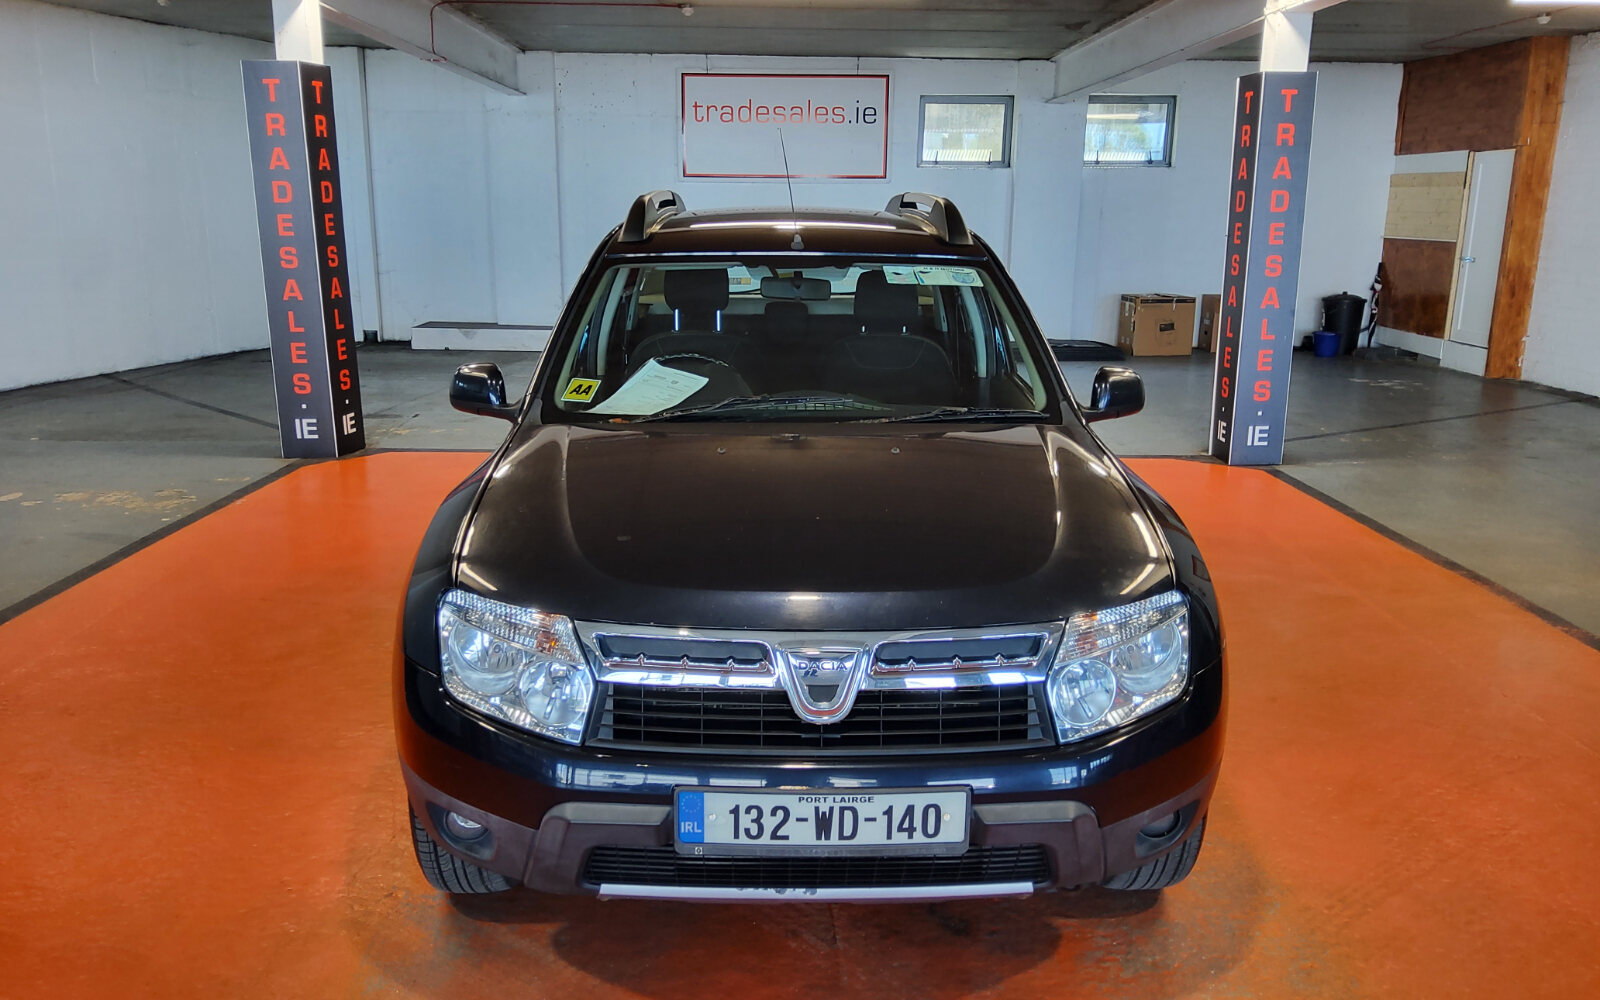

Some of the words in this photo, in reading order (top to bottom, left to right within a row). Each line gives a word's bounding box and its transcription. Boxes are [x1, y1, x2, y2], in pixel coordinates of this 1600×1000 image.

[692, 98, 877, 125] tradesales.ie
[569, 384, 593, 396] AA
[797, 660, 848, 671] DACIA
[798, 796, 829, 804] PORT
[832, 796, 875, 804] LAIRGE
[680, 821, 702, 833] IRL
[728, 803, 942, 841] 132-WD-140
